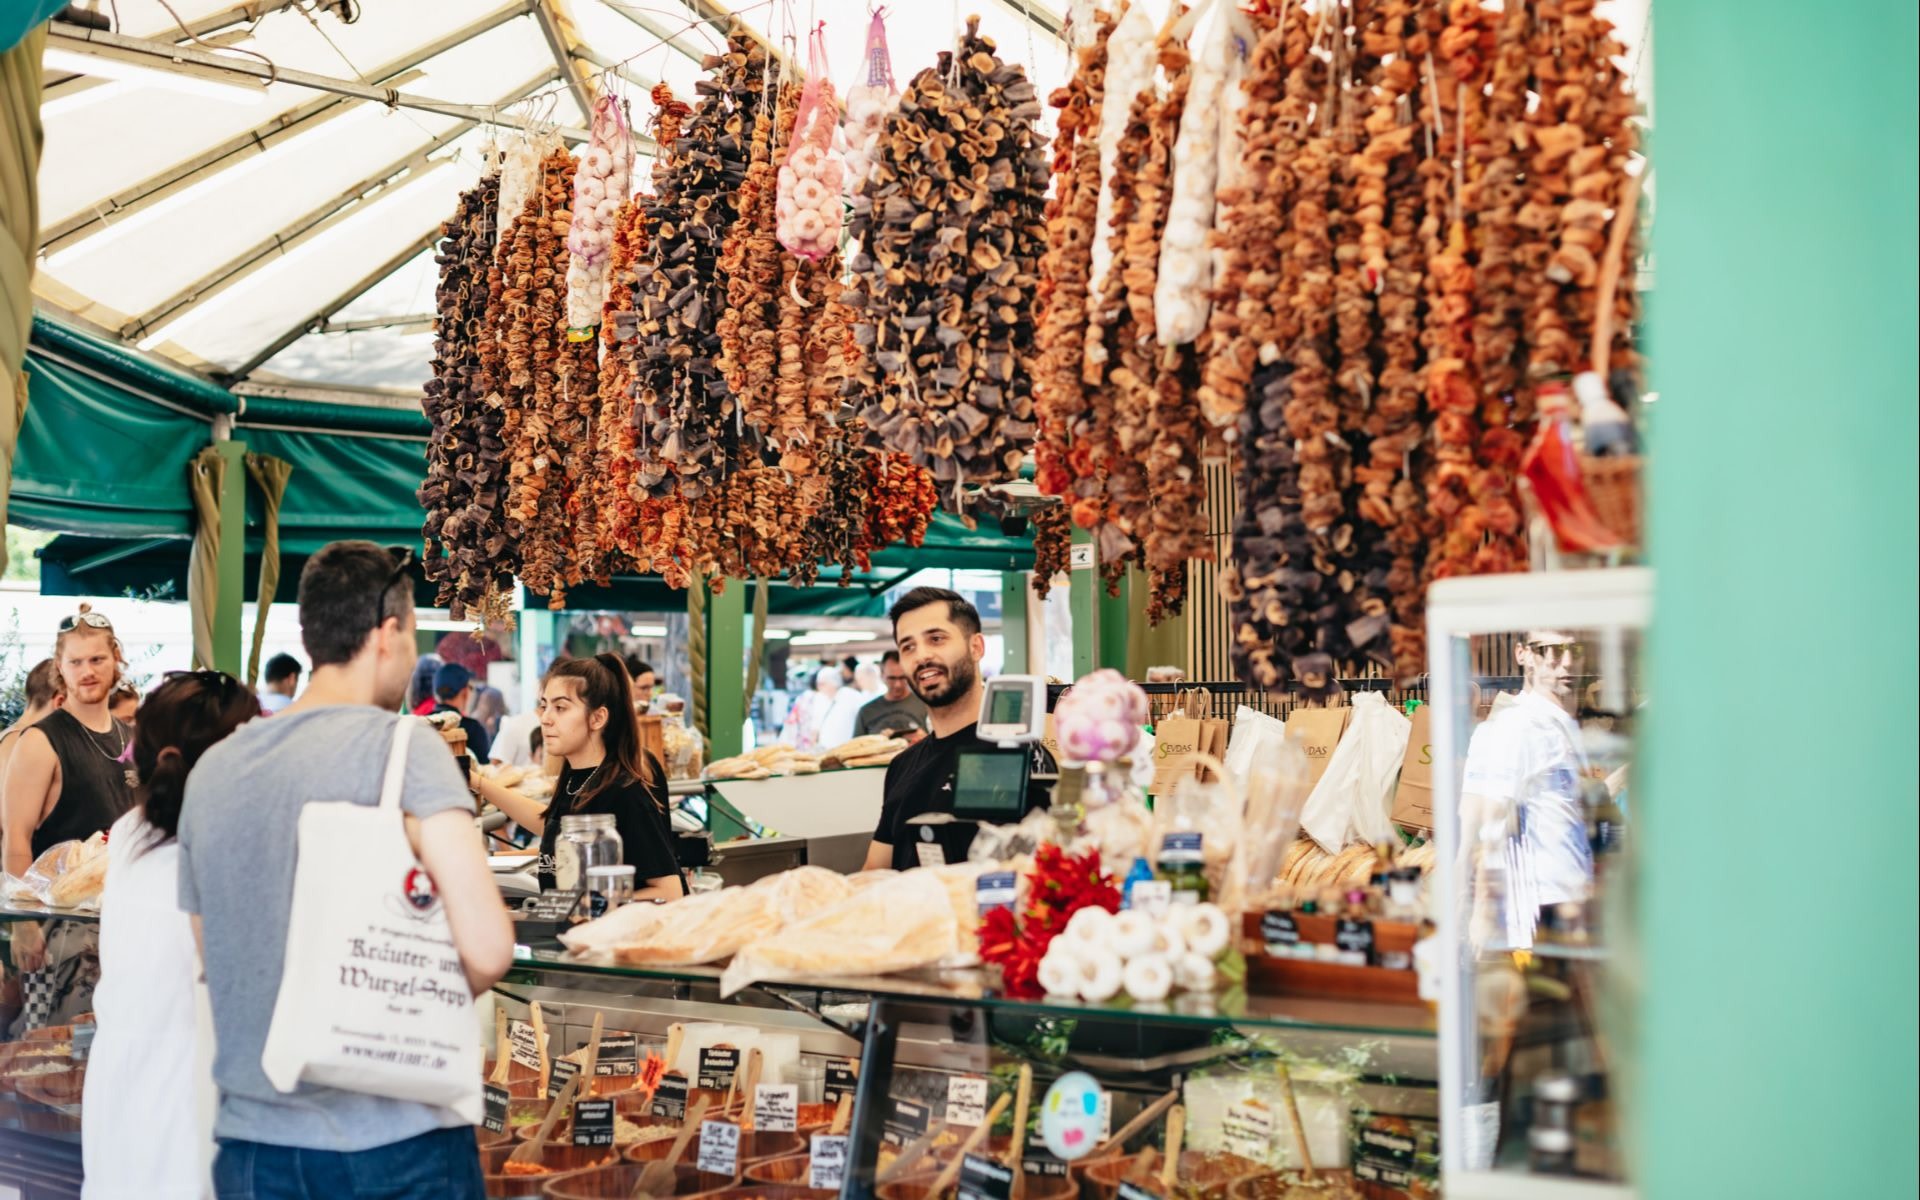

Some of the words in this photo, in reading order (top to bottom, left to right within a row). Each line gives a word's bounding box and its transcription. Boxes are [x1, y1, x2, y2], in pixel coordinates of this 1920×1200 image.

[1158, 742, 1192, 759] SEVDAS
[347, 938, 432, 968] Kräuter-
[339, 965, 466, 1007] Wurzel-Sepp
